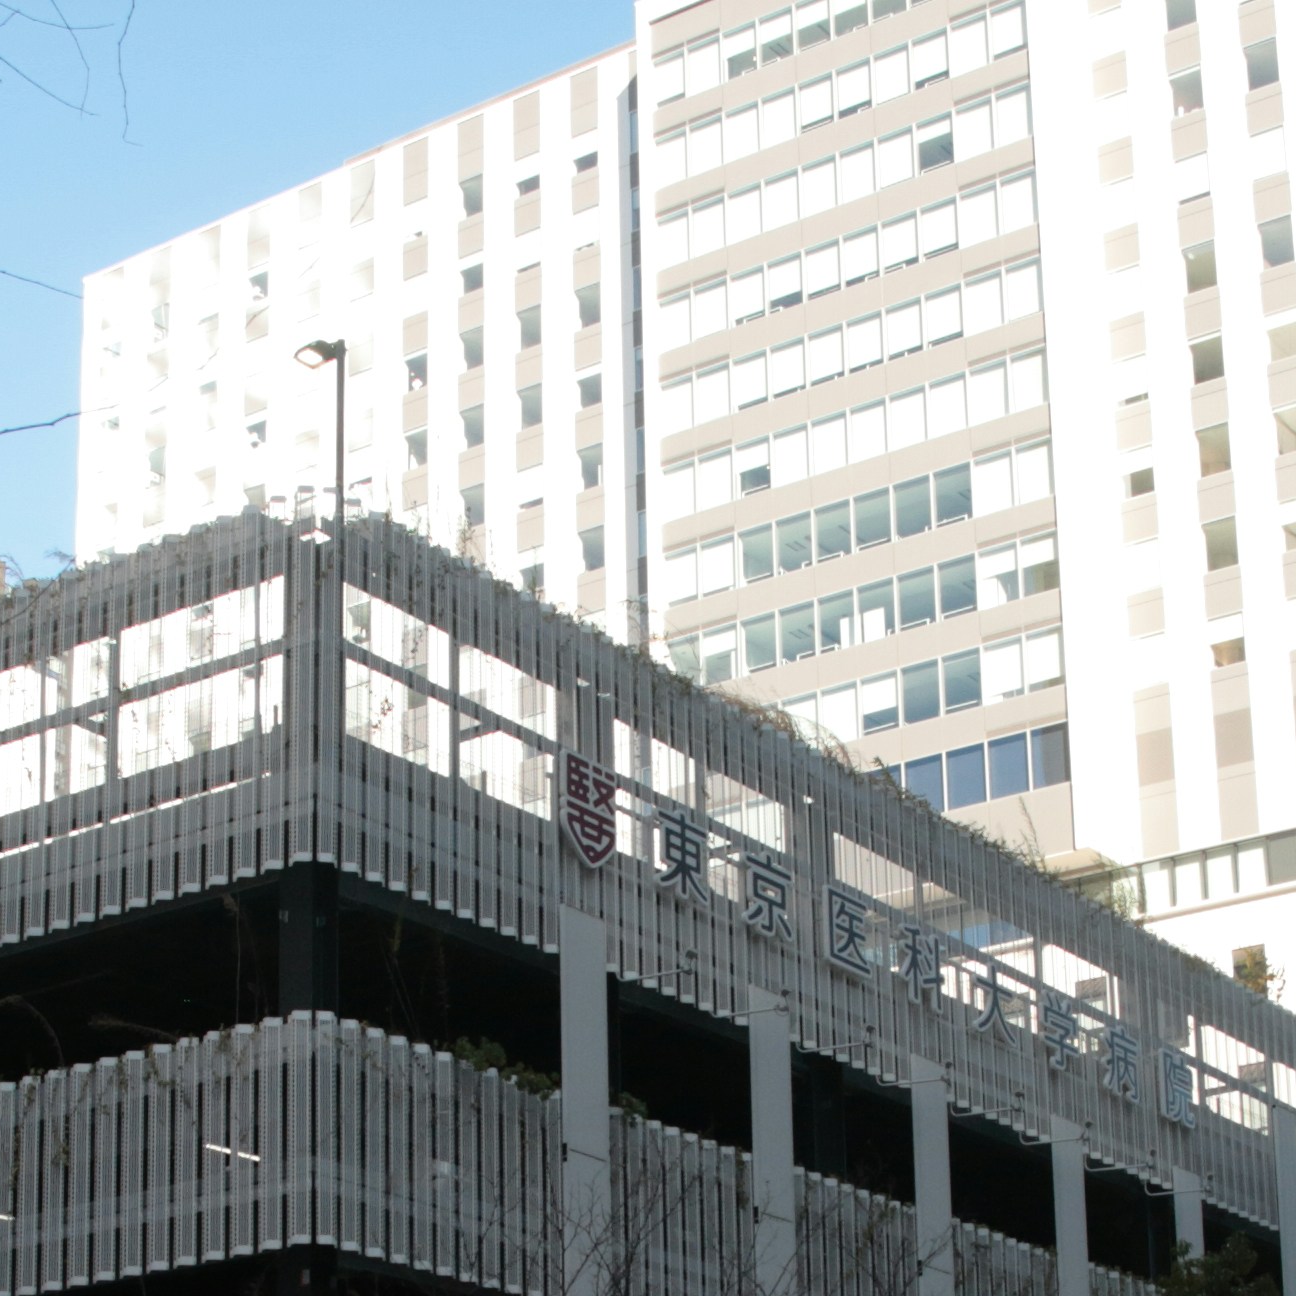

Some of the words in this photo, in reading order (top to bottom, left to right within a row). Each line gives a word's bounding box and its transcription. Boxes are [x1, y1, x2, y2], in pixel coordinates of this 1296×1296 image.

[655, 808, 1197, 1129] 東京医科大学病院
